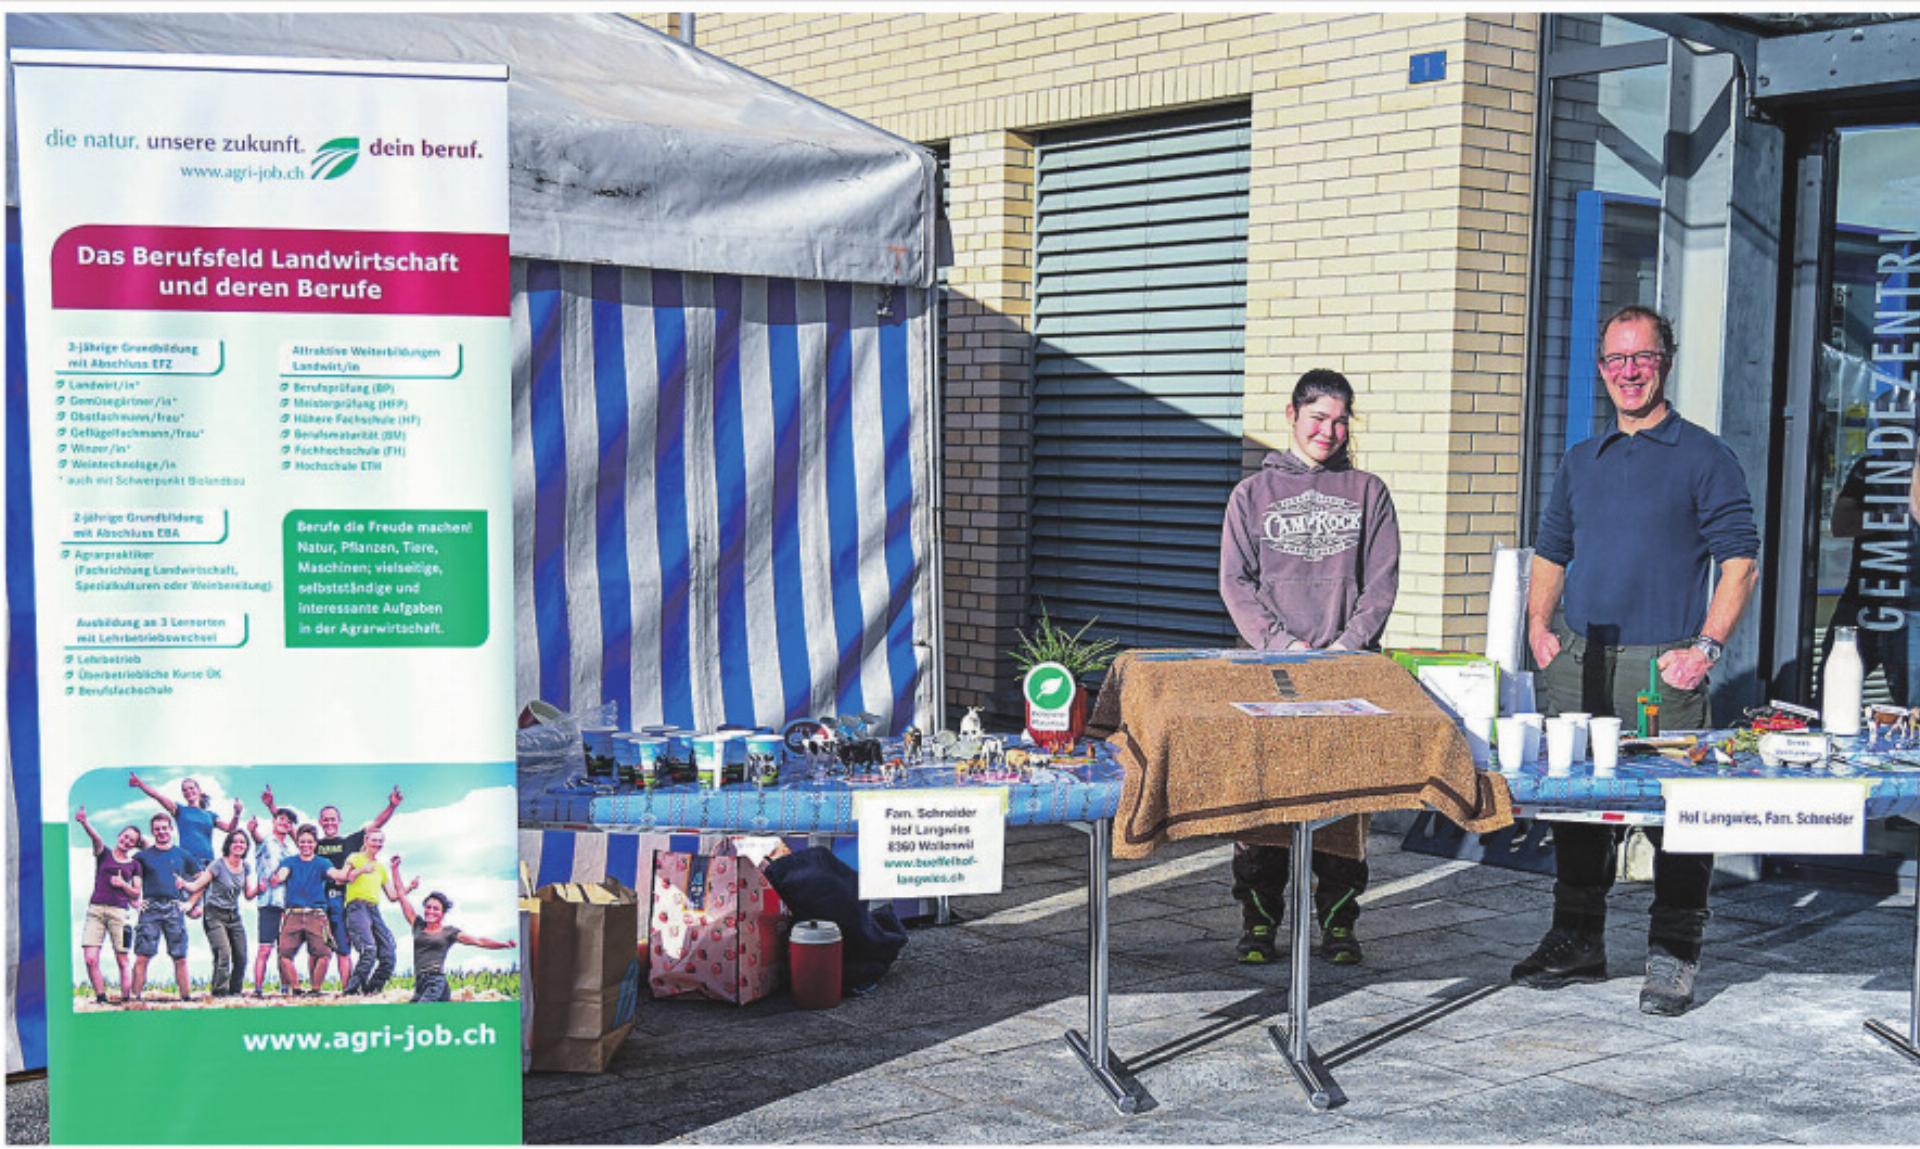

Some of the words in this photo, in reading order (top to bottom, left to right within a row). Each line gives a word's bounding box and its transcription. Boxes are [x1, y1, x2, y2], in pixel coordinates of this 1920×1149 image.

[45, 129, 76, 148] die
[83, 132, 139, 150] natur.
[147, 135, 216, 152] unsere
[222, 134, 304, 154] zukunft.
[370, 139, 415, 157] dein
[422, 141, 483, 159] beruf.
[180, 164, 304, 182] www.agri-job.ch
[77, 245, 125, 266] Das
[133, 247, 263, 268] Berufsfeld
[271, 249, 459, 272] Landwirtschaft
[159, 276, 207, 296] und
[216, 277, 289, 297] deren
[298, 279, 382, 299] Berufe
[122, 343, 198, 356] Grundbildung
[292, 346, 348, 356] Attraktive
[351, 346, 440, 359] Weiterbildungen
[68, 359, 87, 369] mit
[91, 359, 148, 369] Abschluss
[152, 359, 173, 368] EFZ
[292, 362, 360, 372] Landwirt/in
[294, 383, 369, 394] Berufsprüfung
[372, 384, 395, 394] (BP)
[294, 399, 375, 410] Meisterprüfung
[378, 400, 408, 410] (HFP)
[294, 413, 332, 424] Höhere
[336, 414, 395, 424] Fachschule
[398, 415, 420, 426] (HF)
[294, 429, 378, 440] Berufsmaturität
[1857, 233, 1920, 632] GEMEINDEZENTR
[294, 445, 379, 455] Fachhochschule
[383, 446, 406, 457] (FH)
[295, 461, 357, 471] Hochschule
[360, 461, 382, 471] ETH
[116, 476, 185, 487] Schwerpunkt
[127, 513, 203, 525] Grundbildung
[297, 520, 340, 532] Berufe
[344, 521, 364, 532] die
[369, 521, 413, 532] Freude
[418, 522, 473, 533] machen!
[74, 529, 93, 538] mit
[96, 528, 154, 538] Abschluss
[157, 528, 180, 538] EBA
[298, 541, 337, 554] Natur,
[342, 541, 399, 554] Pflanzen,
[403, 541, 439, 554] Tiere,
[74, 550, 154, 561] Agrarpraktiker
[75, 565, 150, 577] (Fachrichtung
[153, 565, 239, 577] Landwirtschaft,
[298, 561, 371, 574] Maschinen;
[375, 561, 443, 576] vielseitige,
[75, 581, 160, 592] Spezialkulturen
[164, 581, 187, 591] oder
[191, 581, 272, 593] Weinbereitung)
[299, 582, 392, 596] selbstständige
[396, 582, 420, 594] und
[299, 602, 378, 614] interessante
[383, 602, 443, 616] Aufgaben
[76, 618, 140, 629] Ausbildung
[160, 618, 167, 627] 3
[171, 617, 225, 627] Lernorten
[299, 622, 310, 634] in
[315, 622, 336, 634] der
[340, 622, 444, 636] Agrarwirtschaft.
[77, 634, 96, 643] mit
[77, 654, 141, 664] Lehrbetrieb
[78, 668, 169, 680] Überbetriebliche
[173, 669, 203, 679] Kurse
[78, 685, 173, 696] Berufsfachschule
[885, 808, 913, 819] Fam.
[918, 807, 976, 818] Schneider
[1679, 811, 1699, 824] Hof
[1703, 811, 1762, 827] Langwies,
[1765, 811, 1793, 824] Fam.
[1797, 811, 1854, 825] Schneider
[891, 825, 911, 835] Hof
[915, 825, 971, 837] Langwies
[888, 841, 915, 852] 8360
[243, 1023, 496, 1052] www.agri-job.ch
